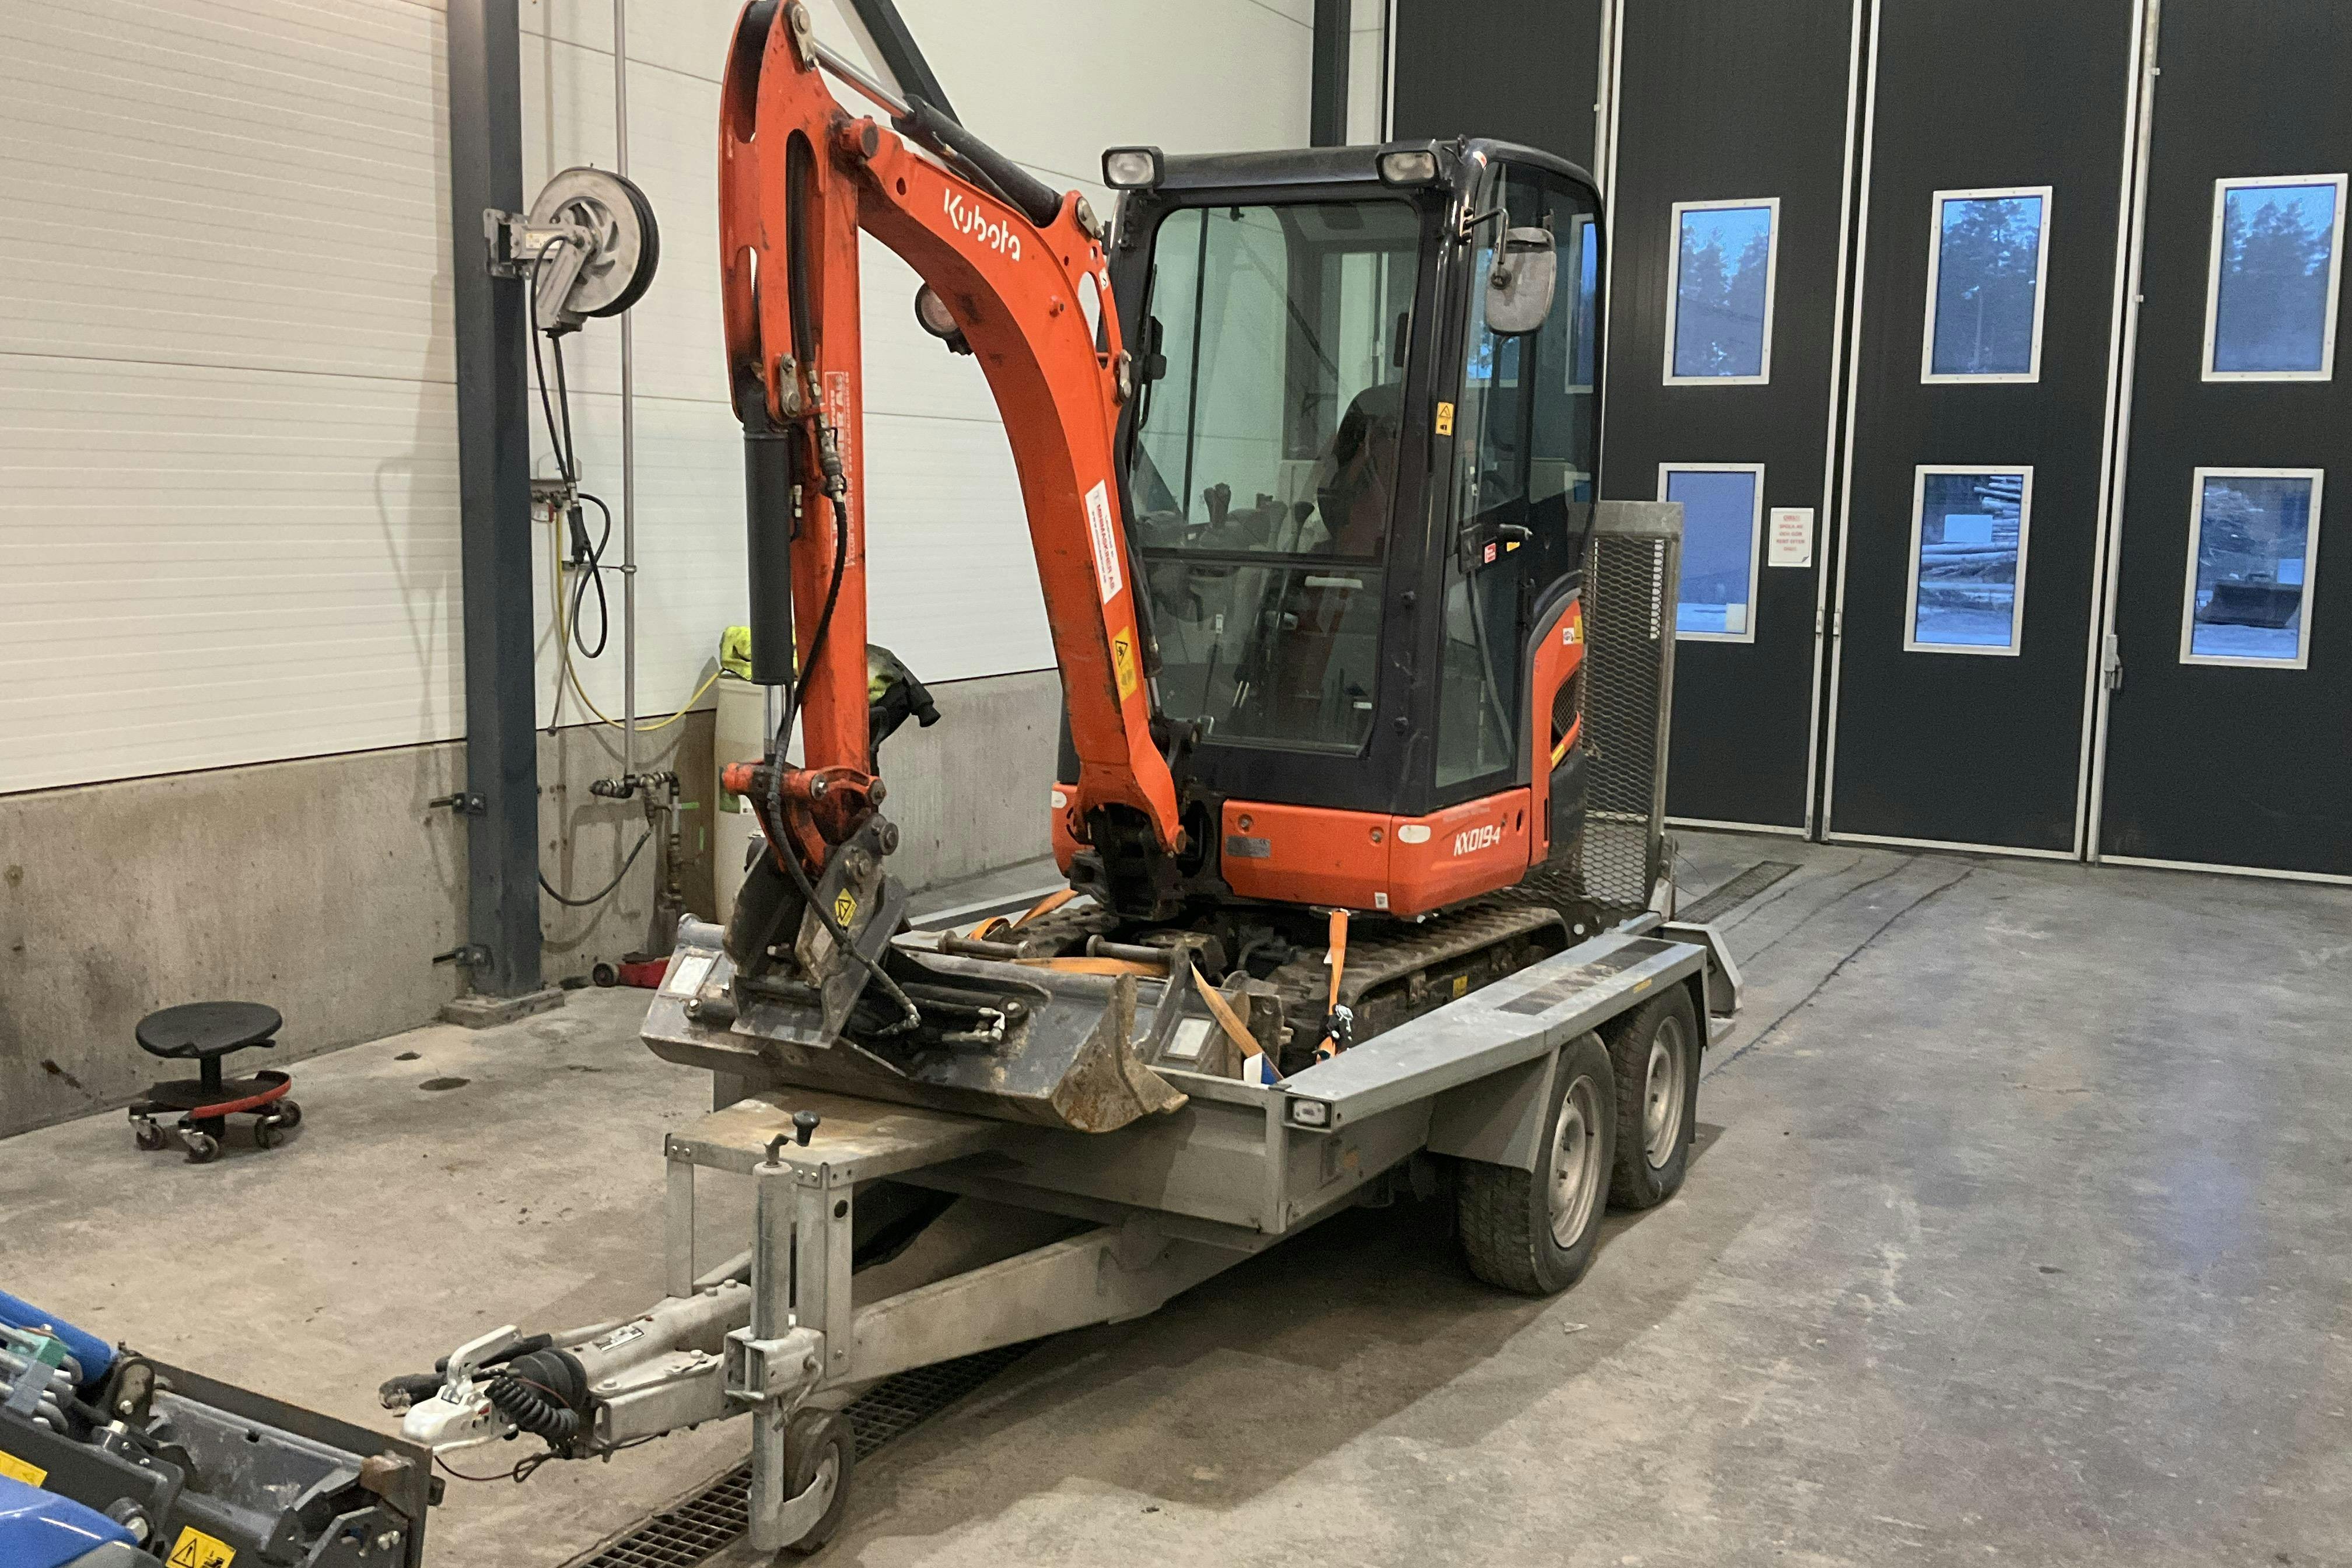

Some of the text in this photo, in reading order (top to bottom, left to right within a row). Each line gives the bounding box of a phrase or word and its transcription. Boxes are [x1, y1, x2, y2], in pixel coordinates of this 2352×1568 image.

[943, 188, 1021, 262] Kubota
[1096, 503, 1115, 590] MINIMASKINER AB
